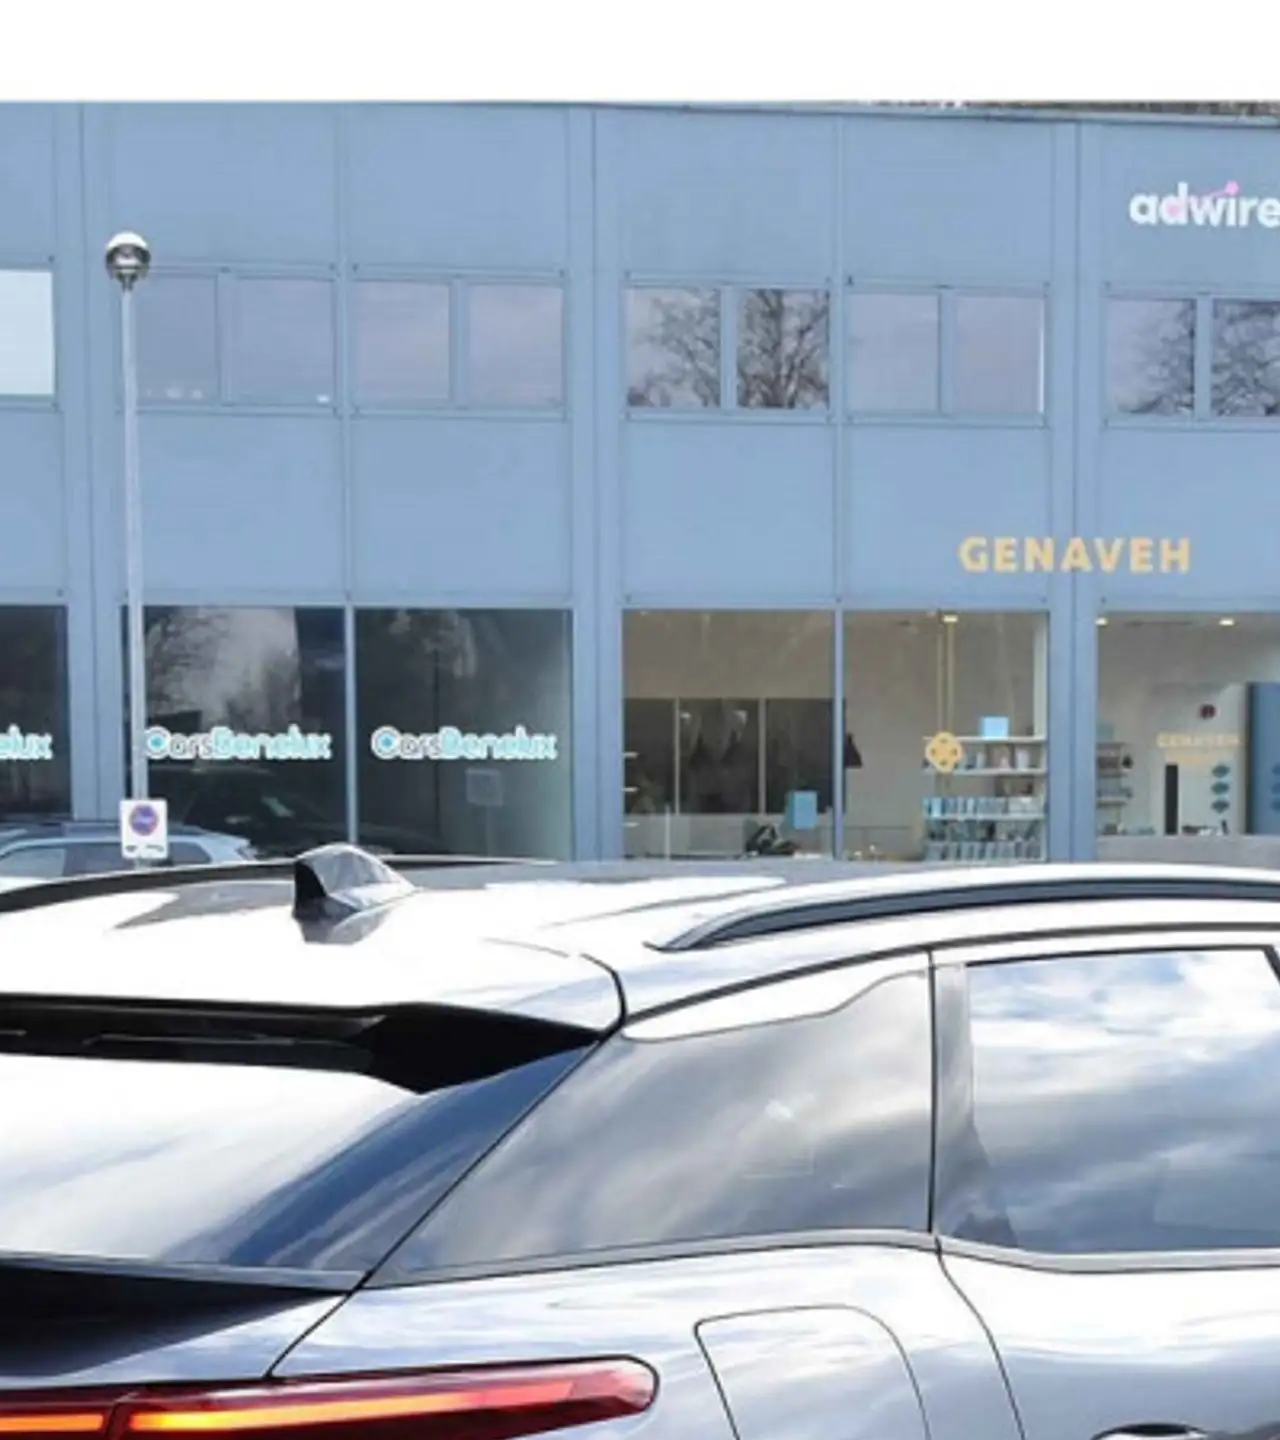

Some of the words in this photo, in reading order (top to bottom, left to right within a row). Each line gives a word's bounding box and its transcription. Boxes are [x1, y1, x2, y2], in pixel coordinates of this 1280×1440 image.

[958, 535, 1191, 574] GENAVEH
[145, 724, 332, 760] CarsBenelux
[372, 725, 558, 760] CarsBenelux
